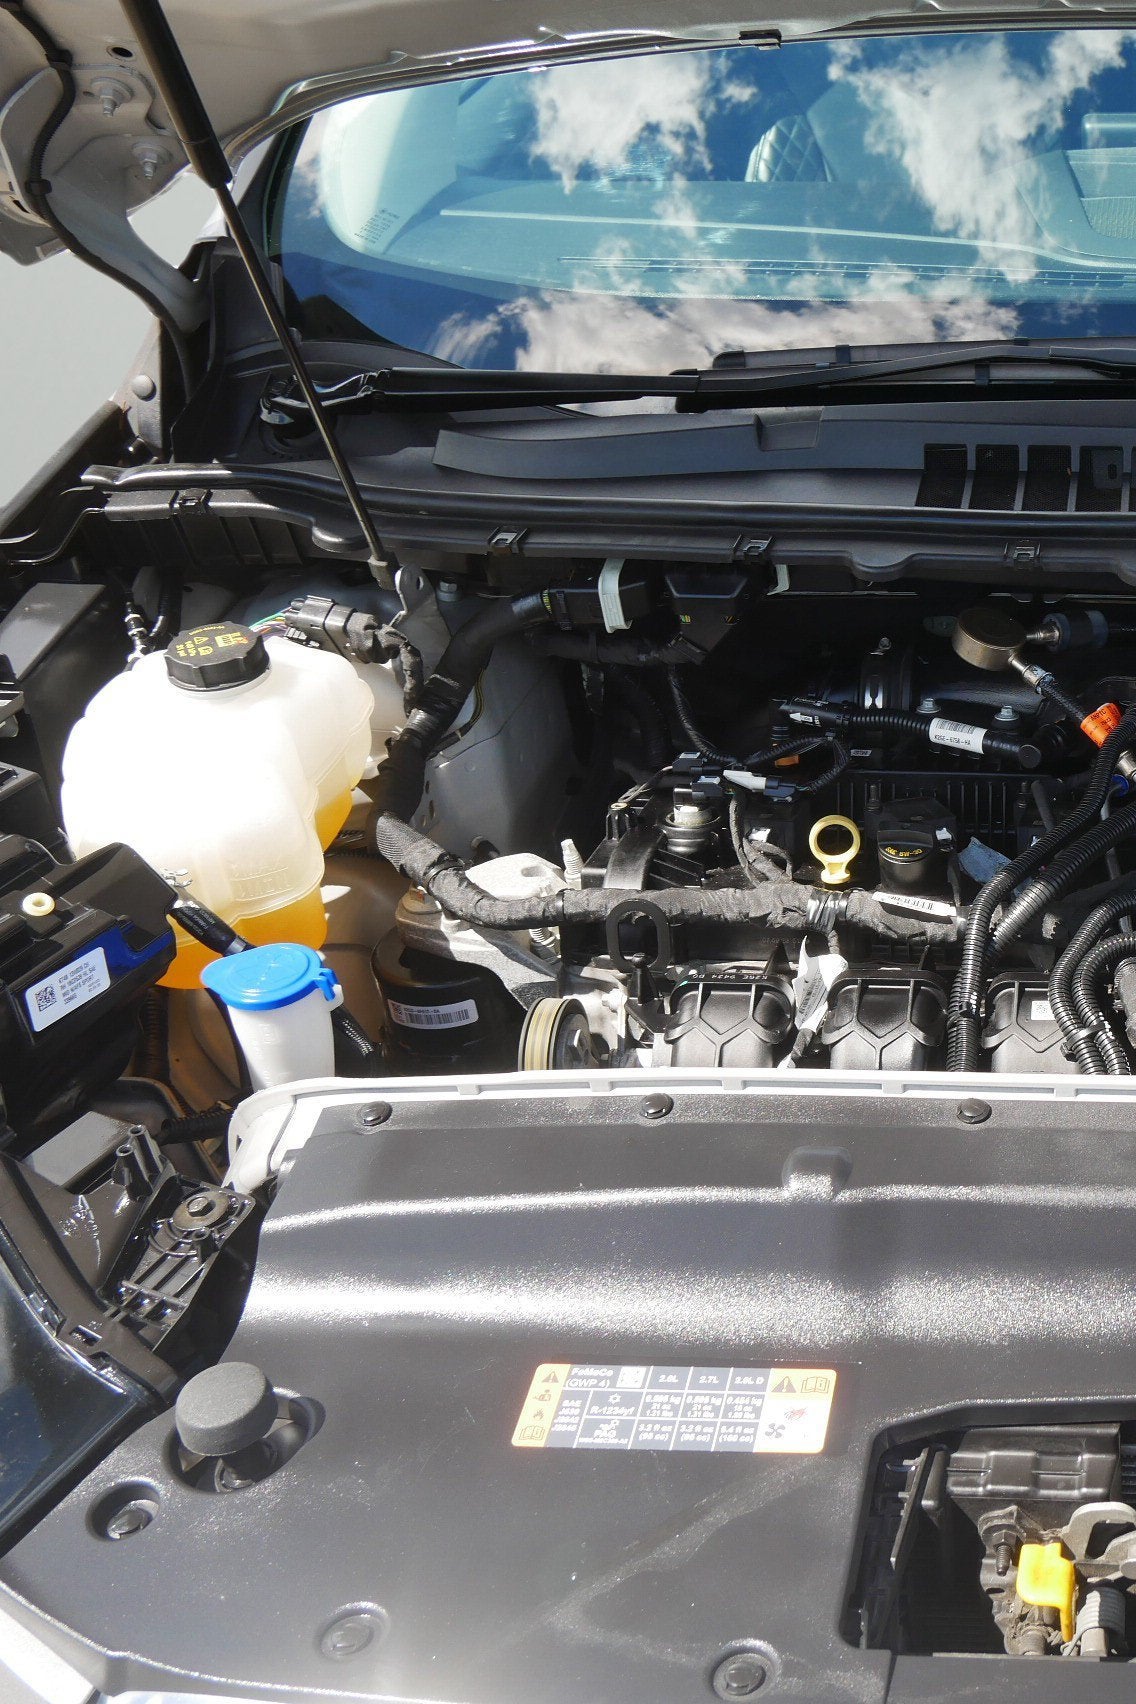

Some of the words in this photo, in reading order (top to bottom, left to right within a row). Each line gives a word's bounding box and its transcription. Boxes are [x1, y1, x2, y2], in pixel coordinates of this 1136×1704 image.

[885, 846, 898, 856] SAE
[598, 1378, 611, 1389] 4)
[589, 1405, 636, 1417] R-1234yf
